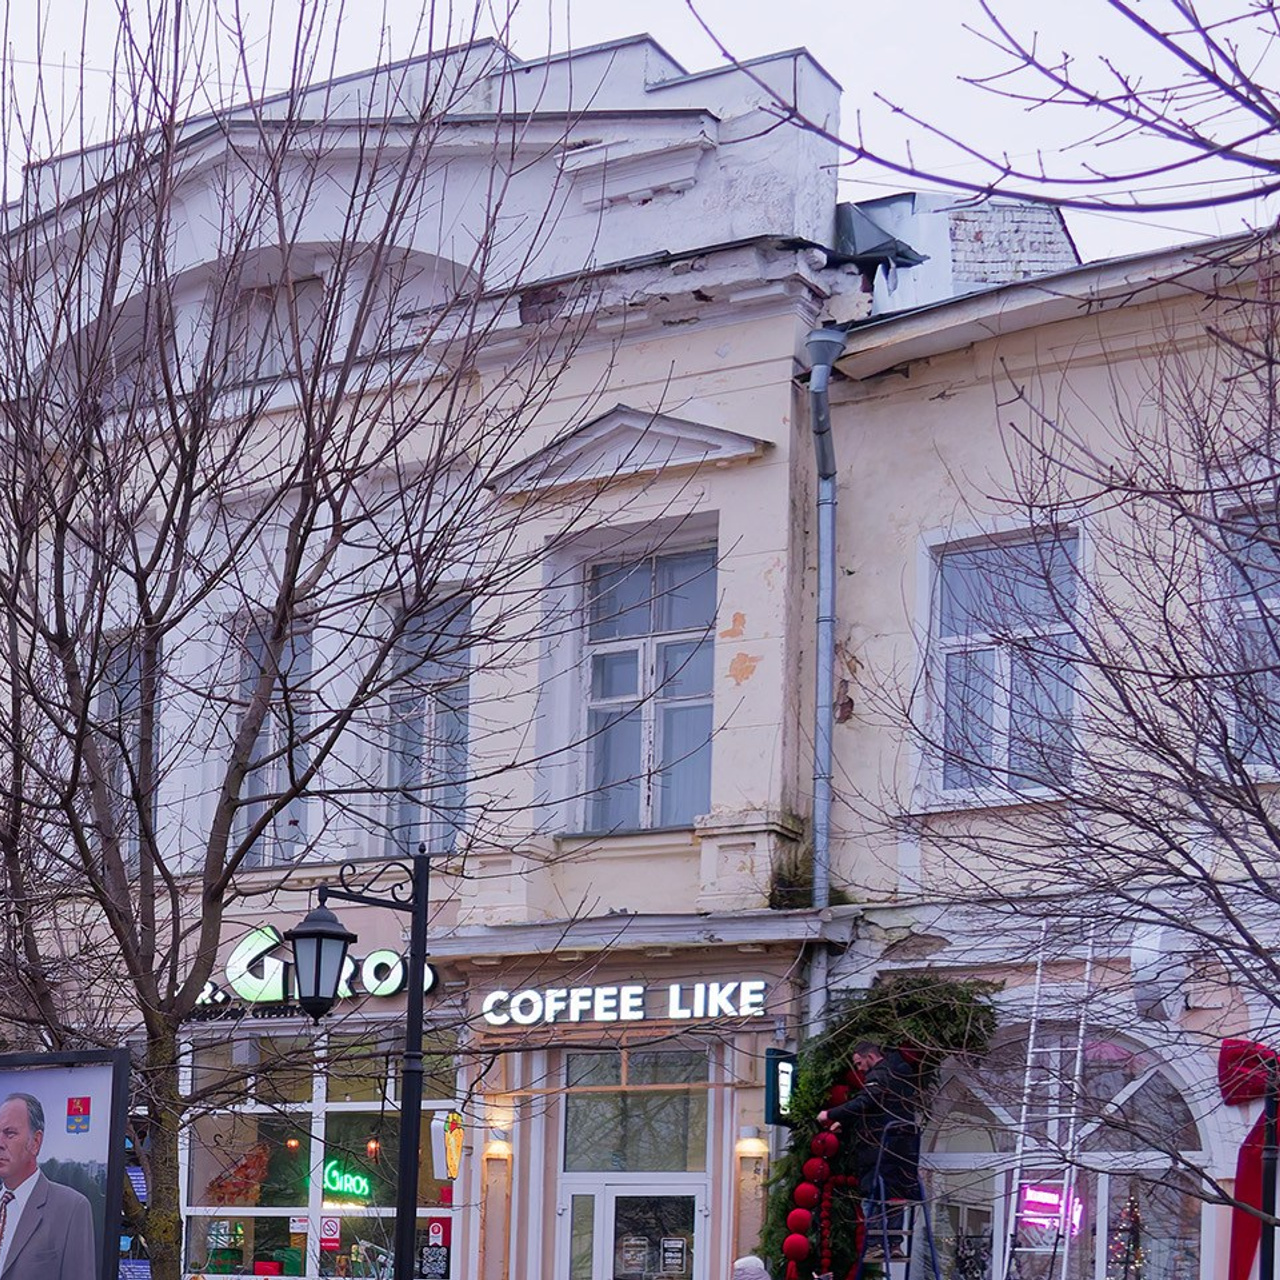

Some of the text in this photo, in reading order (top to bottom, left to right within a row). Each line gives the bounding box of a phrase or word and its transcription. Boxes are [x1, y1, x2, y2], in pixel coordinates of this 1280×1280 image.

[225, 925, 435, 1003] GRO
[482, 981, 766, 1025] COFFEE LIKE
